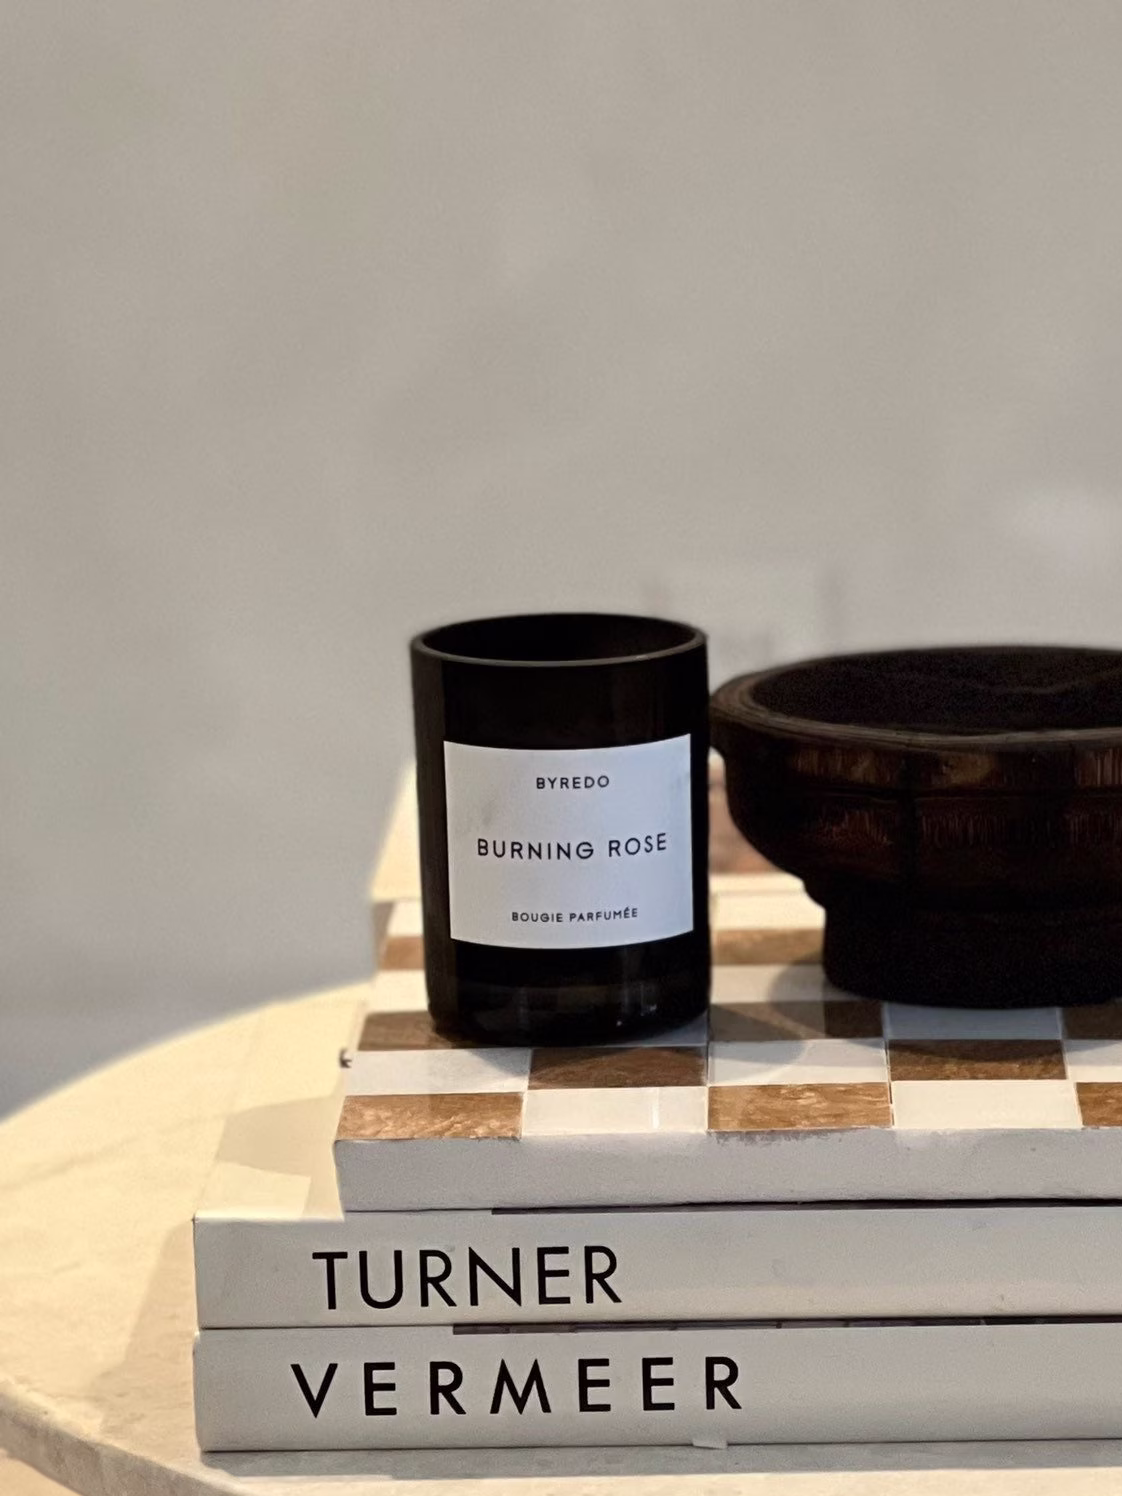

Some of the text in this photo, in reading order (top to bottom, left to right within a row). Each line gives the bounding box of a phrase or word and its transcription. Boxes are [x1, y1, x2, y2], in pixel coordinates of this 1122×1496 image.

[535, 775, 610, 790] BYREDO
[476, 832, 668, 860] BURNING ROSE
[511, 906, 639, 923] BOUGIE PARFUMÉE
[312, 1245, 623, 1311] TURNER
[290, 1355, 743, 1419] VERMEER
